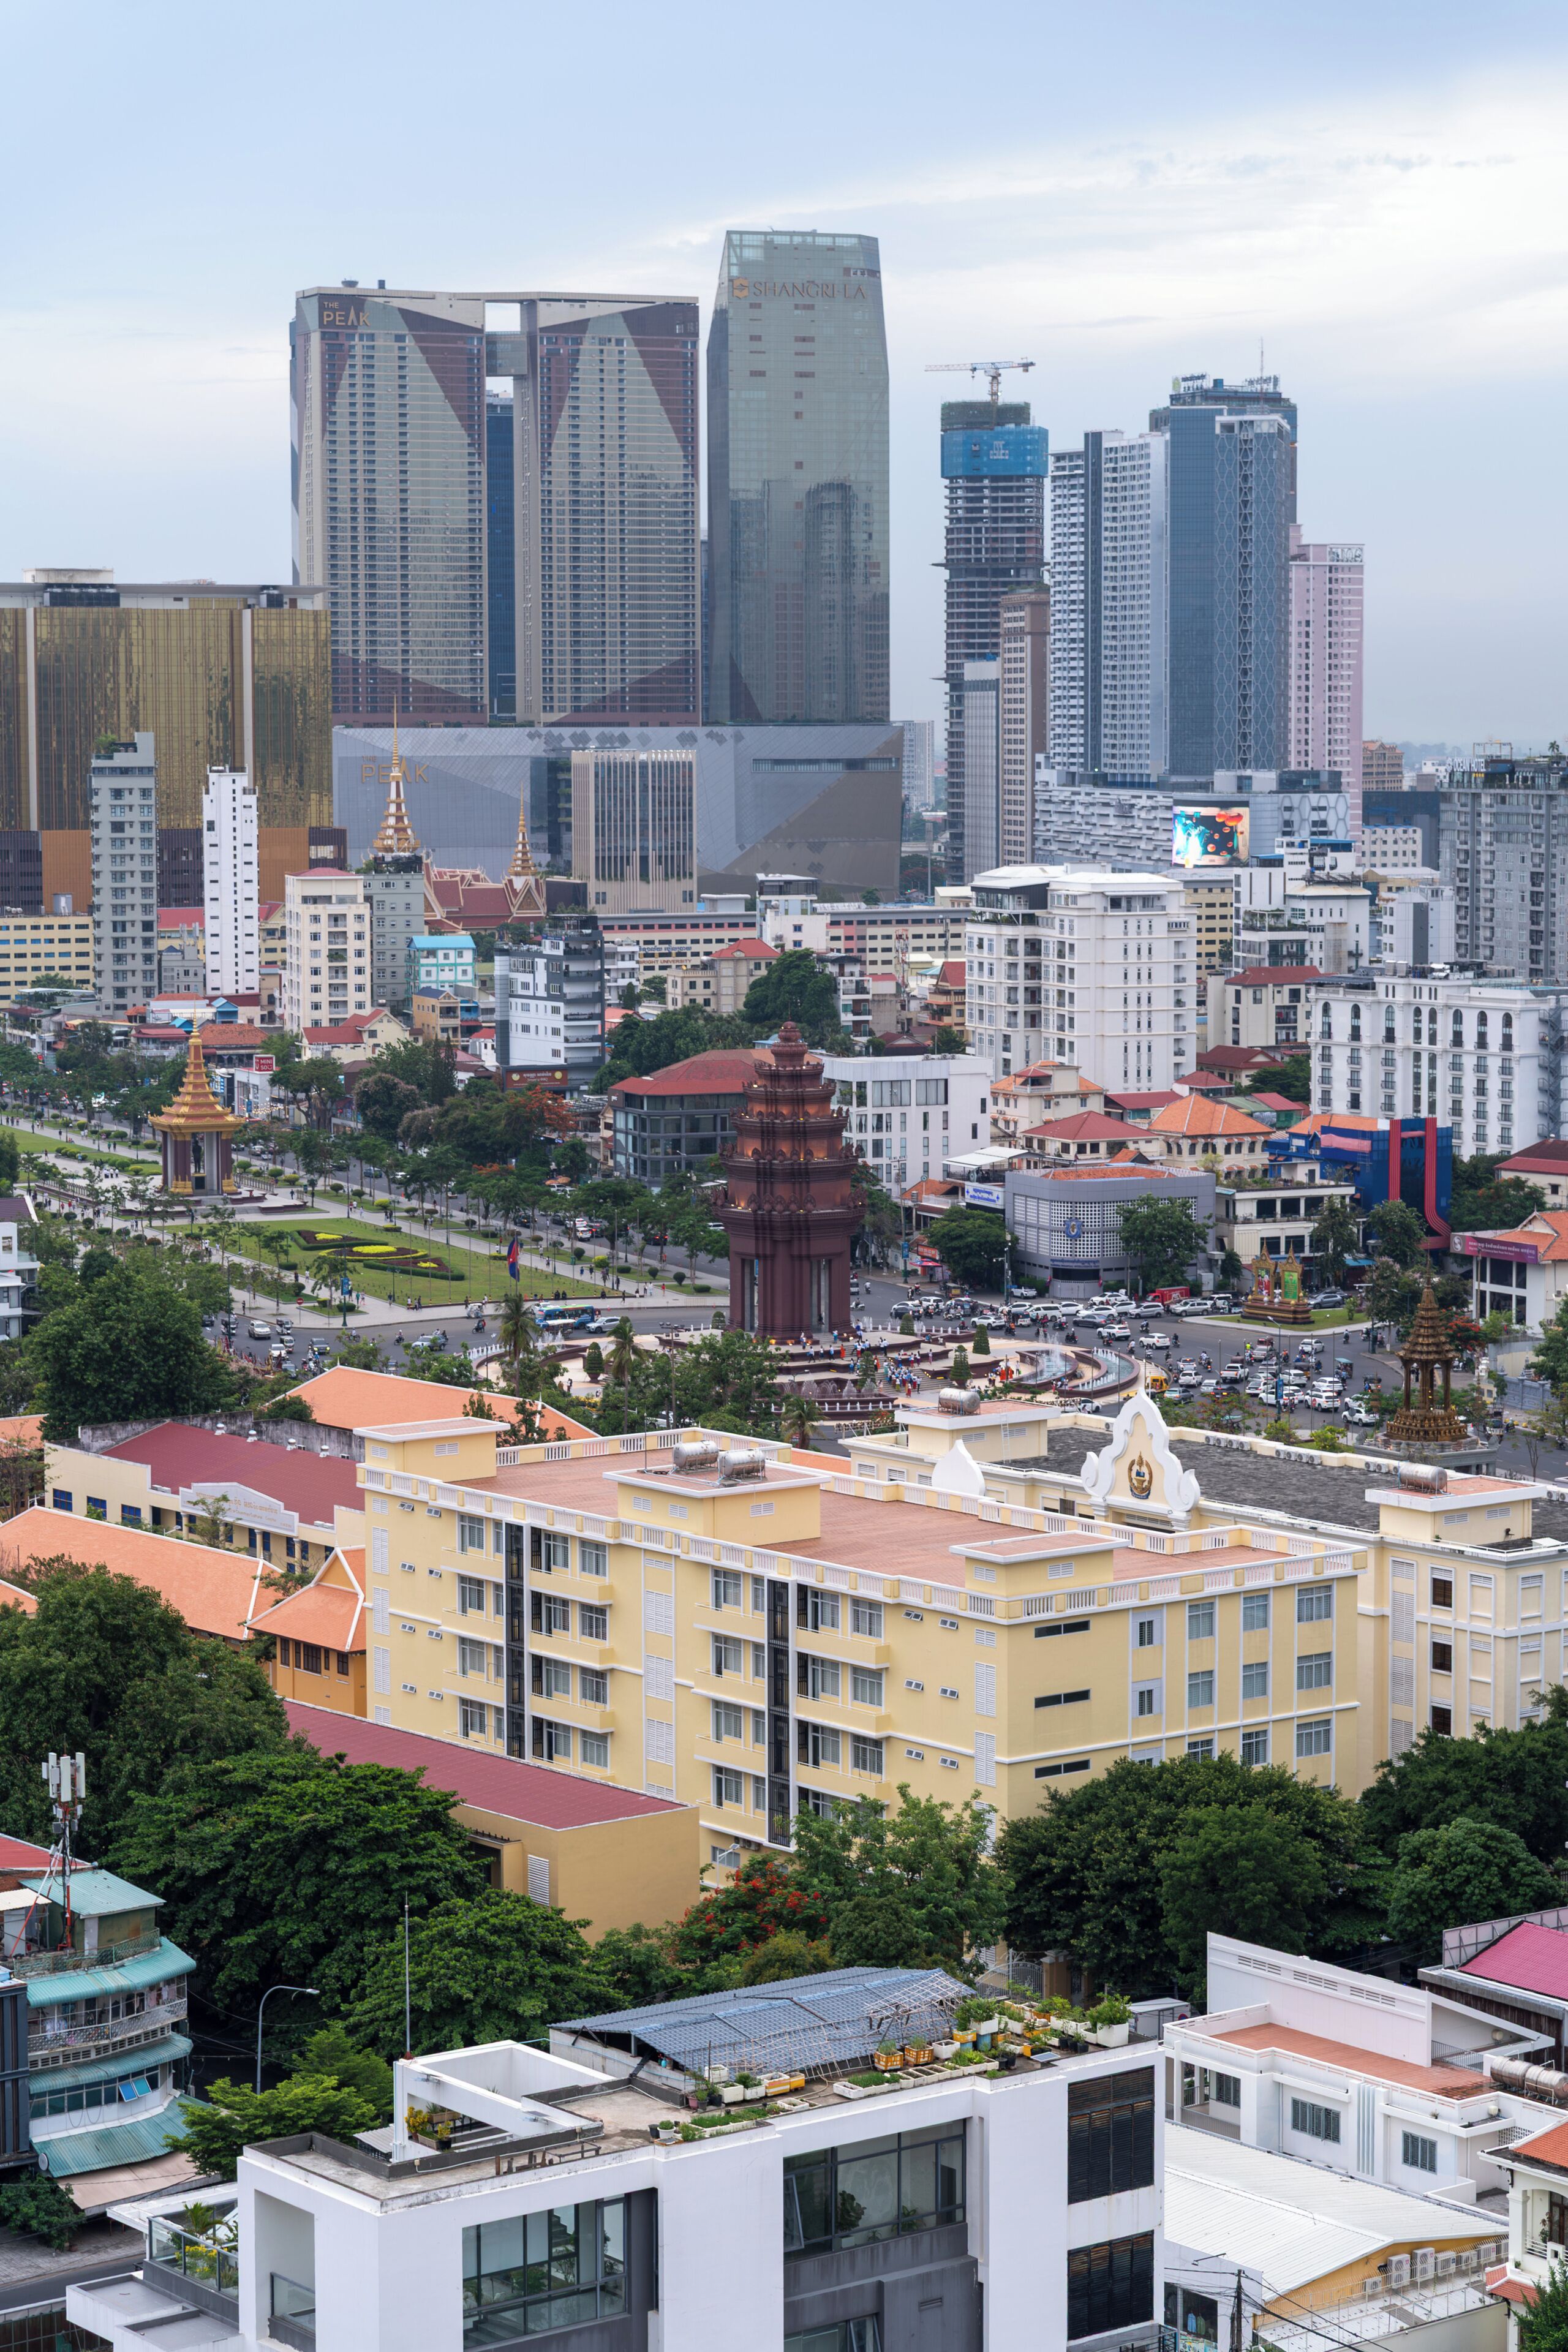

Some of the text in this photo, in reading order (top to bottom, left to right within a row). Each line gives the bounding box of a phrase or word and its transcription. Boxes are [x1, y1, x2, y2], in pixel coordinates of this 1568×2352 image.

[753, 281, 867, 300] SHANGRI-LA
[323, 306, 371, 326] PEAK
[361, 754, 429, 783] PEAK
[1453, 758, 1486, 772] OCEAN HOTEL
